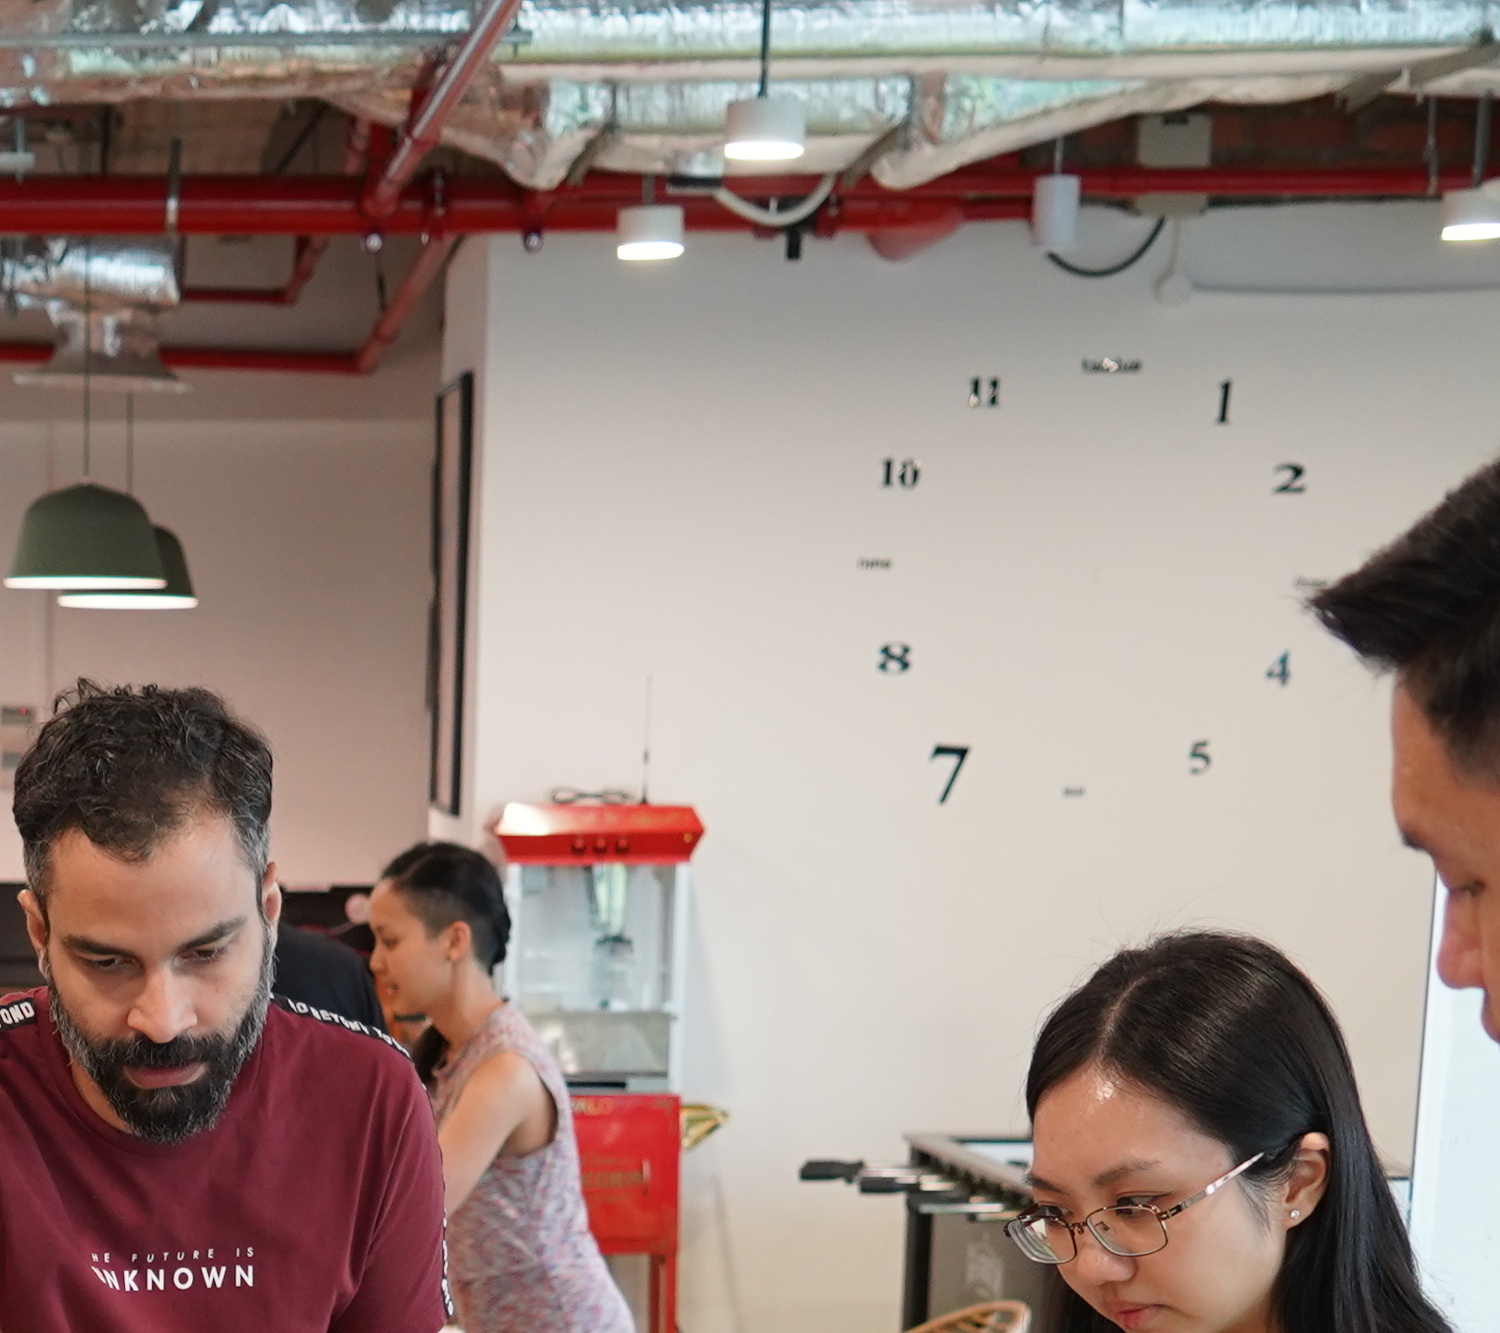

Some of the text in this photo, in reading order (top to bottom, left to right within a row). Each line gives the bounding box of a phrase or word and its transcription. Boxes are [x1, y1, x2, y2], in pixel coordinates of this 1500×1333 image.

[968, 376, 1002, 408] 11
[1214, 379, 1233, 426] 1
[880, 457, 921, 489] 10
[1272, 462, 1308, 494] 2
[878, 642, 913, 675] 8
[1266, 651, 1292, 686] 4
[1188, 739, 1212, 774] 5
[929, 744, 971, 804] 7
[91, 1247, 255, 1263] HE FUTURE IS
